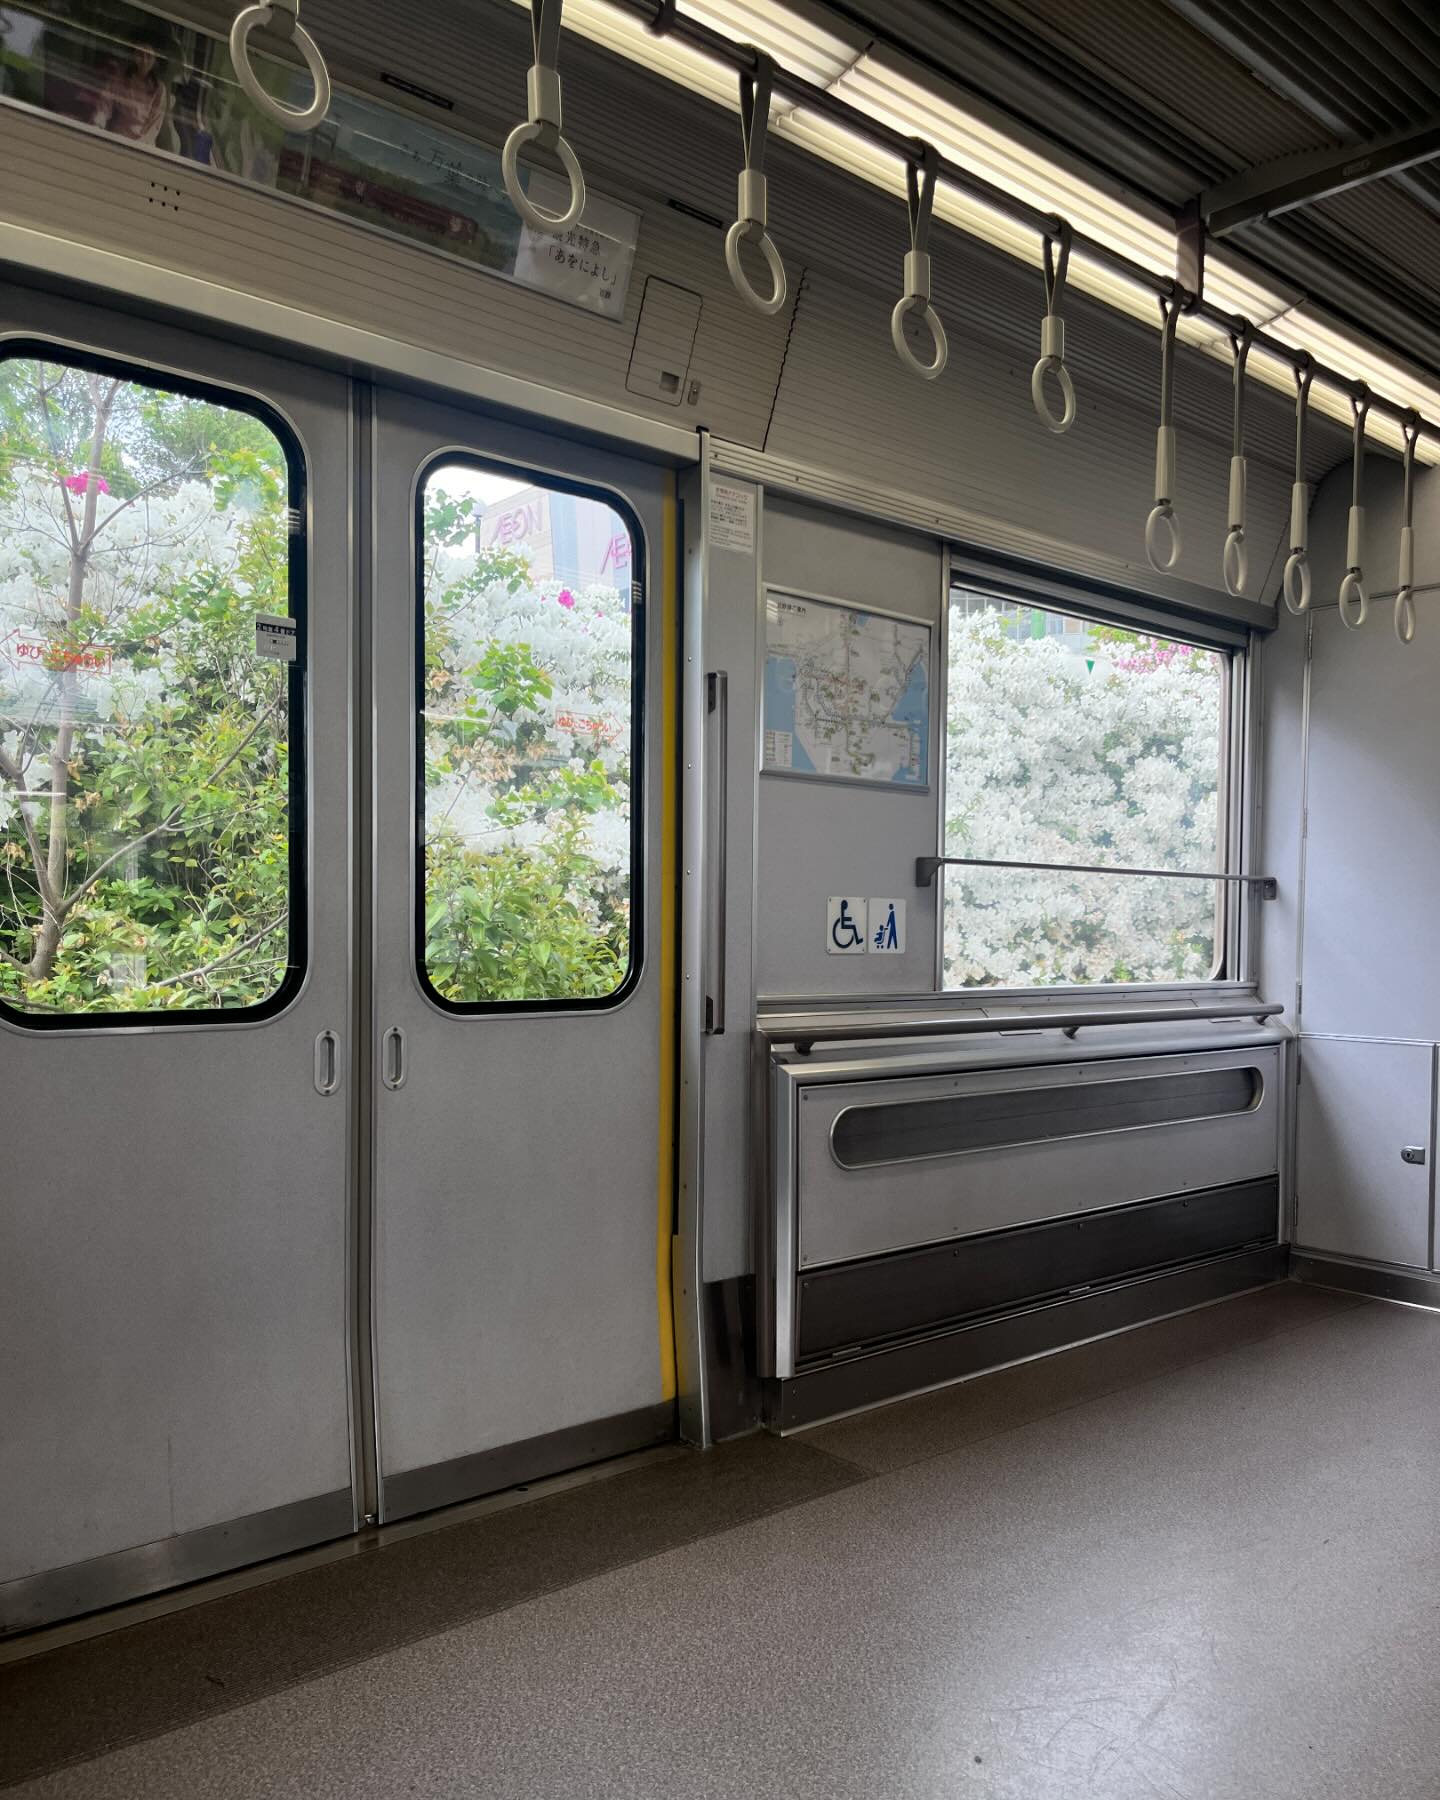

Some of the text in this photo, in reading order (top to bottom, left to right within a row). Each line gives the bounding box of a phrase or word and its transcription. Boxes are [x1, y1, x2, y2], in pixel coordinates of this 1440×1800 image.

[549, 245, 618, 286] 「あをによし」
